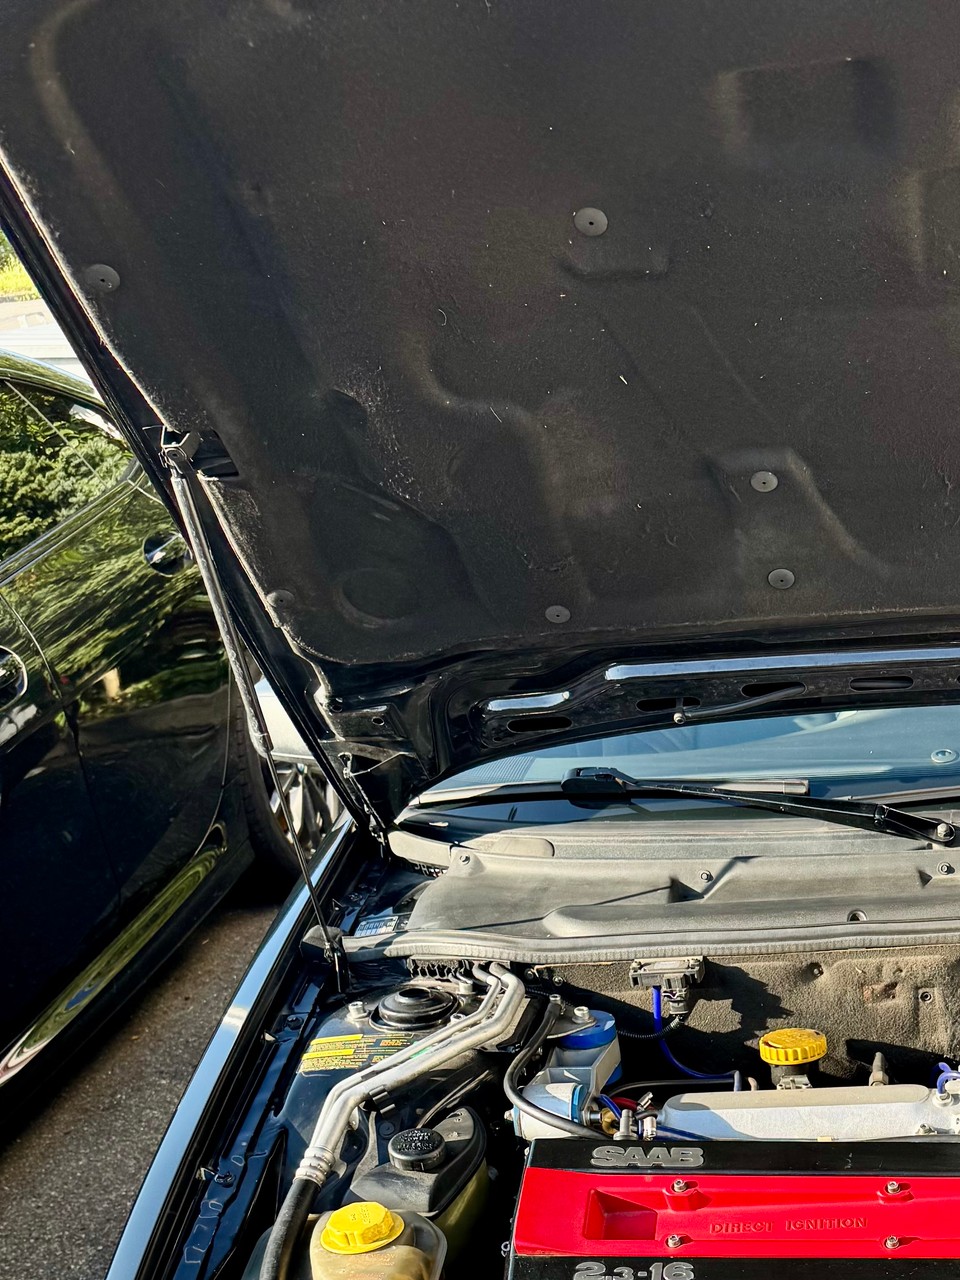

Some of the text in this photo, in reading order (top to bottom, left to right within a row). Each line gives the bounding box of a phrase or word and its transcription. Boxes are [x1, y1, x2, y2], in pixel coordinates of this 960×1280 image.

[590, 1145, 704, 1168] SAAB
[710, 1217, 868, 1233] DIRECT IGNITION
